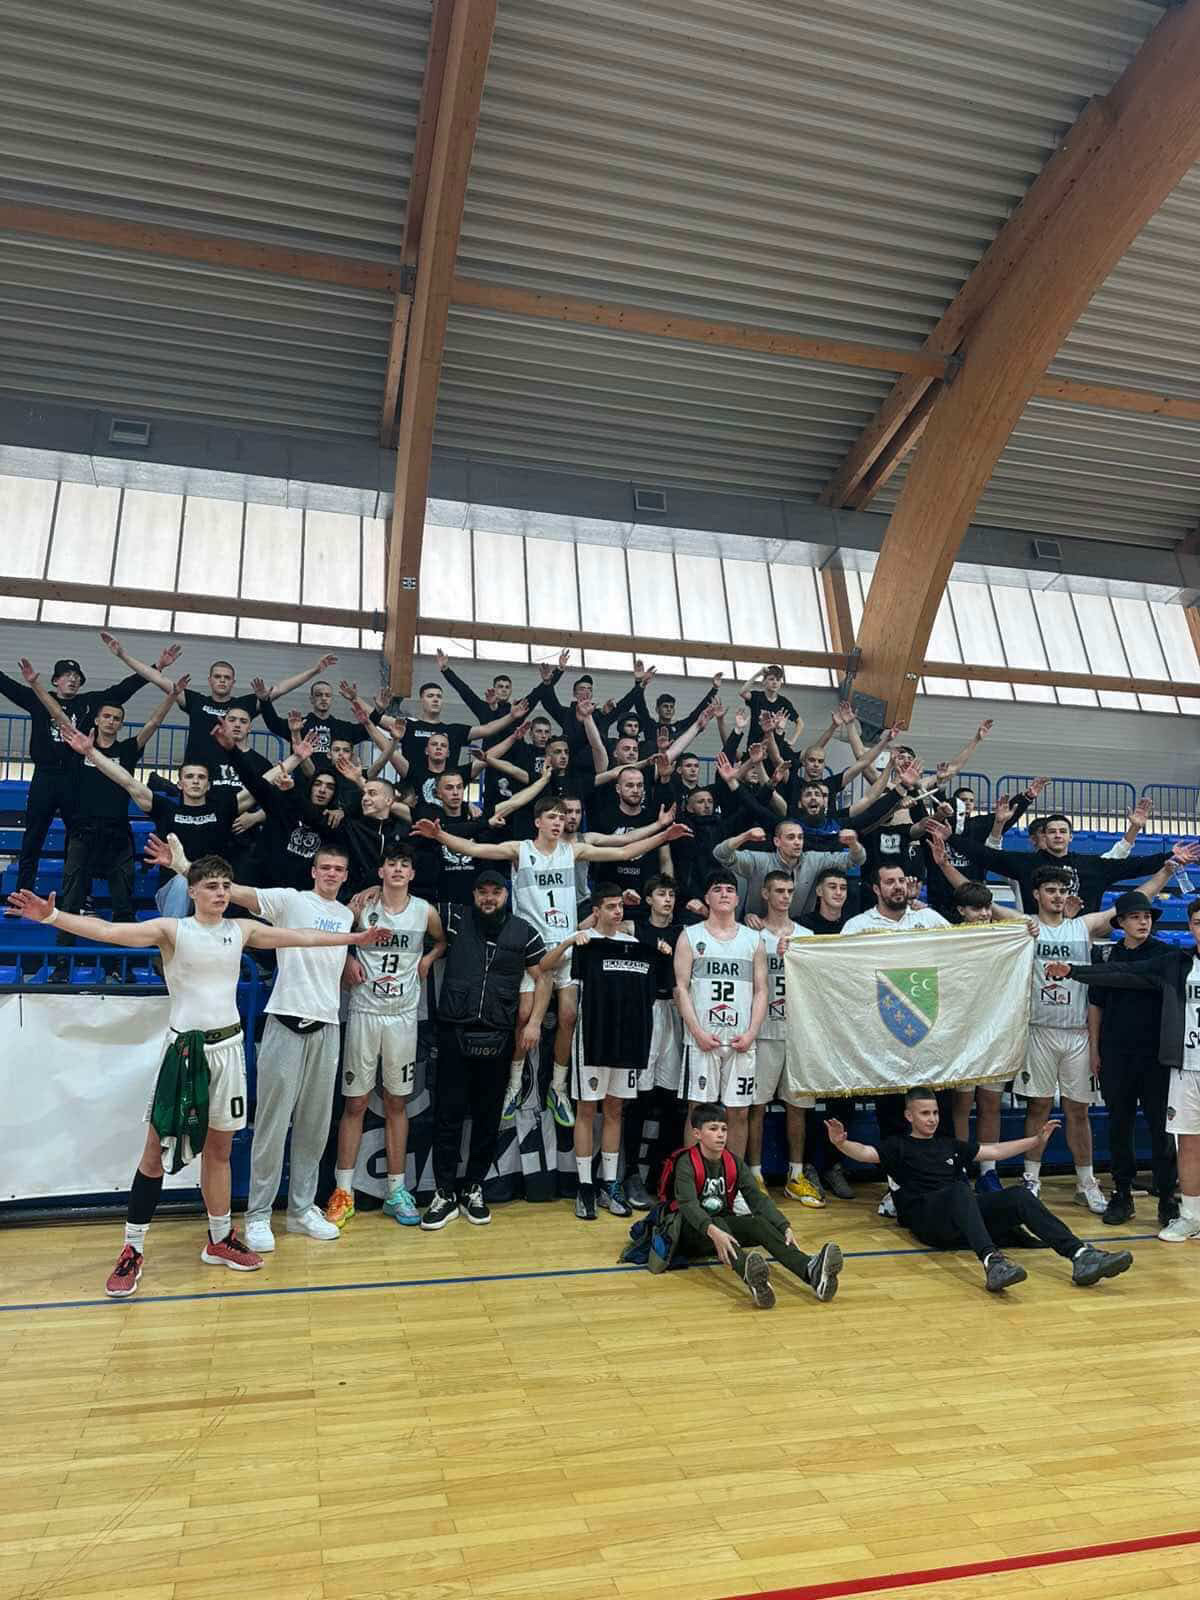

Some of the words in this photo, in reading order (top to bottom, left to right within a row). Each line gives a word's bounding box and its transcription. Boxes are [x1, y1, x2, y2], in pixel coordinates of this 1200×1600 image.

[547, 890, 555, 907] 1
[1037, 944, 1070, 957] IBAR
[382, 954, 399, 974] 13
[707, 961, 739, 976] IBAR
[711, 981, 734, 1001] 32
[401, 1063, 415, 1083] 13
[230, 1096, 244, 1118] 0
